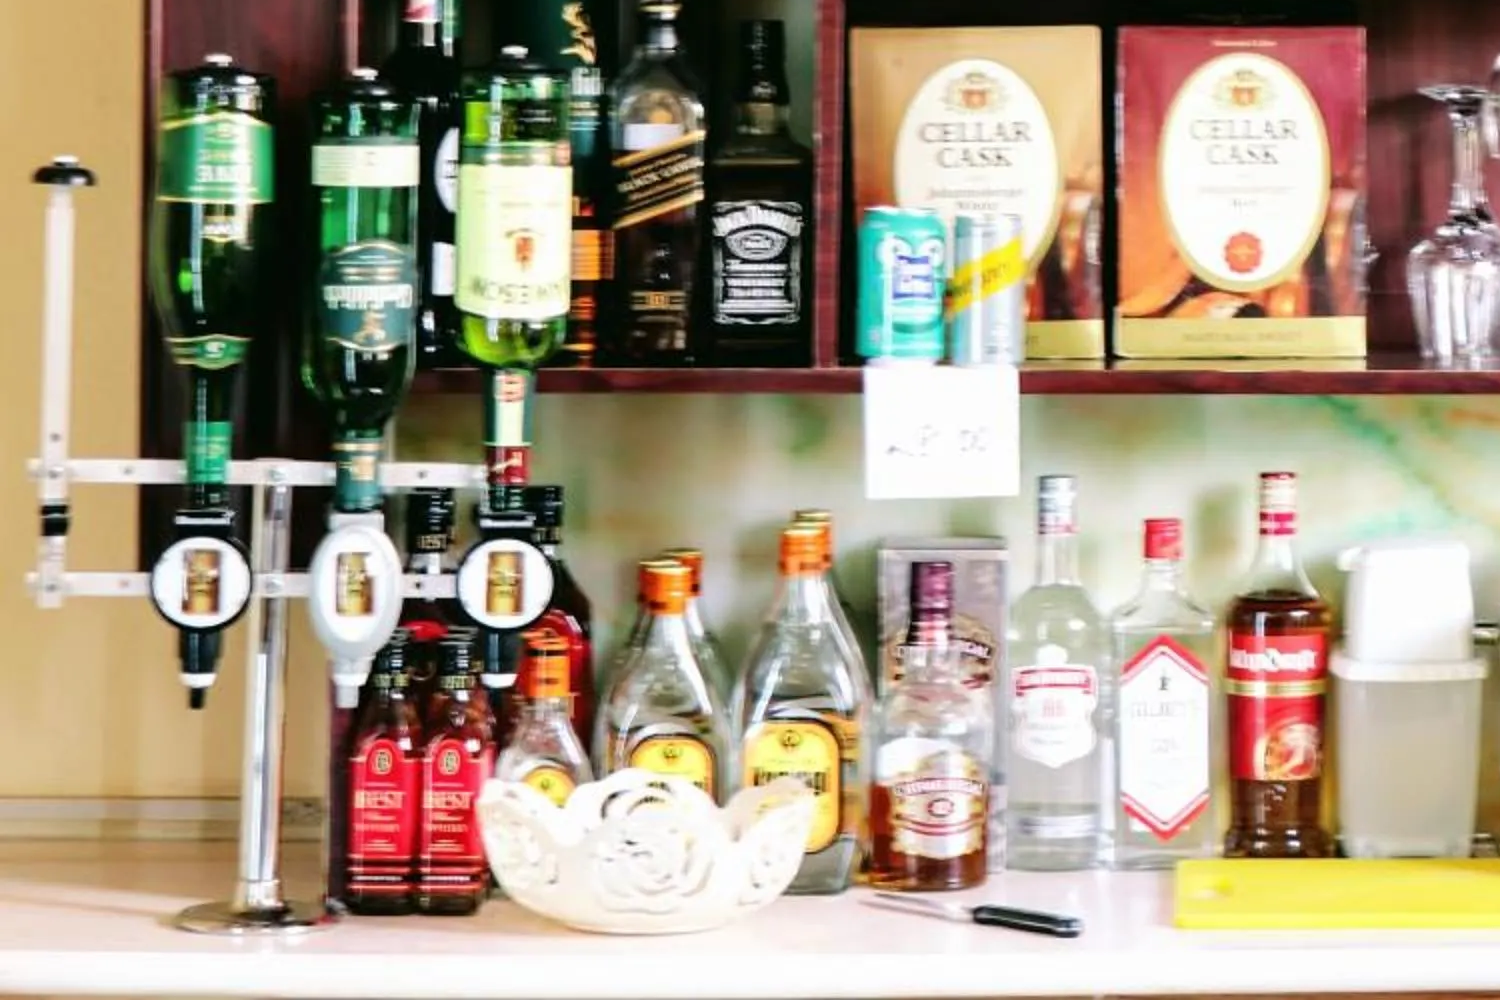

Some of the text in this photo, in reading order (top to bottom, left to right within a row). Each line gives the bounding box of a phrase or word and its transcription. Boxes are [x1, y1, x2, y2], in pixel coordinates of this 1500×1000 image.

[917, 122, 1033, 143] CELLAR
[1190, 119, 1299, 140] CELLAR
[936, 147, 1014, 168] CASK
[1206, 144, 1280, 165] CASK
